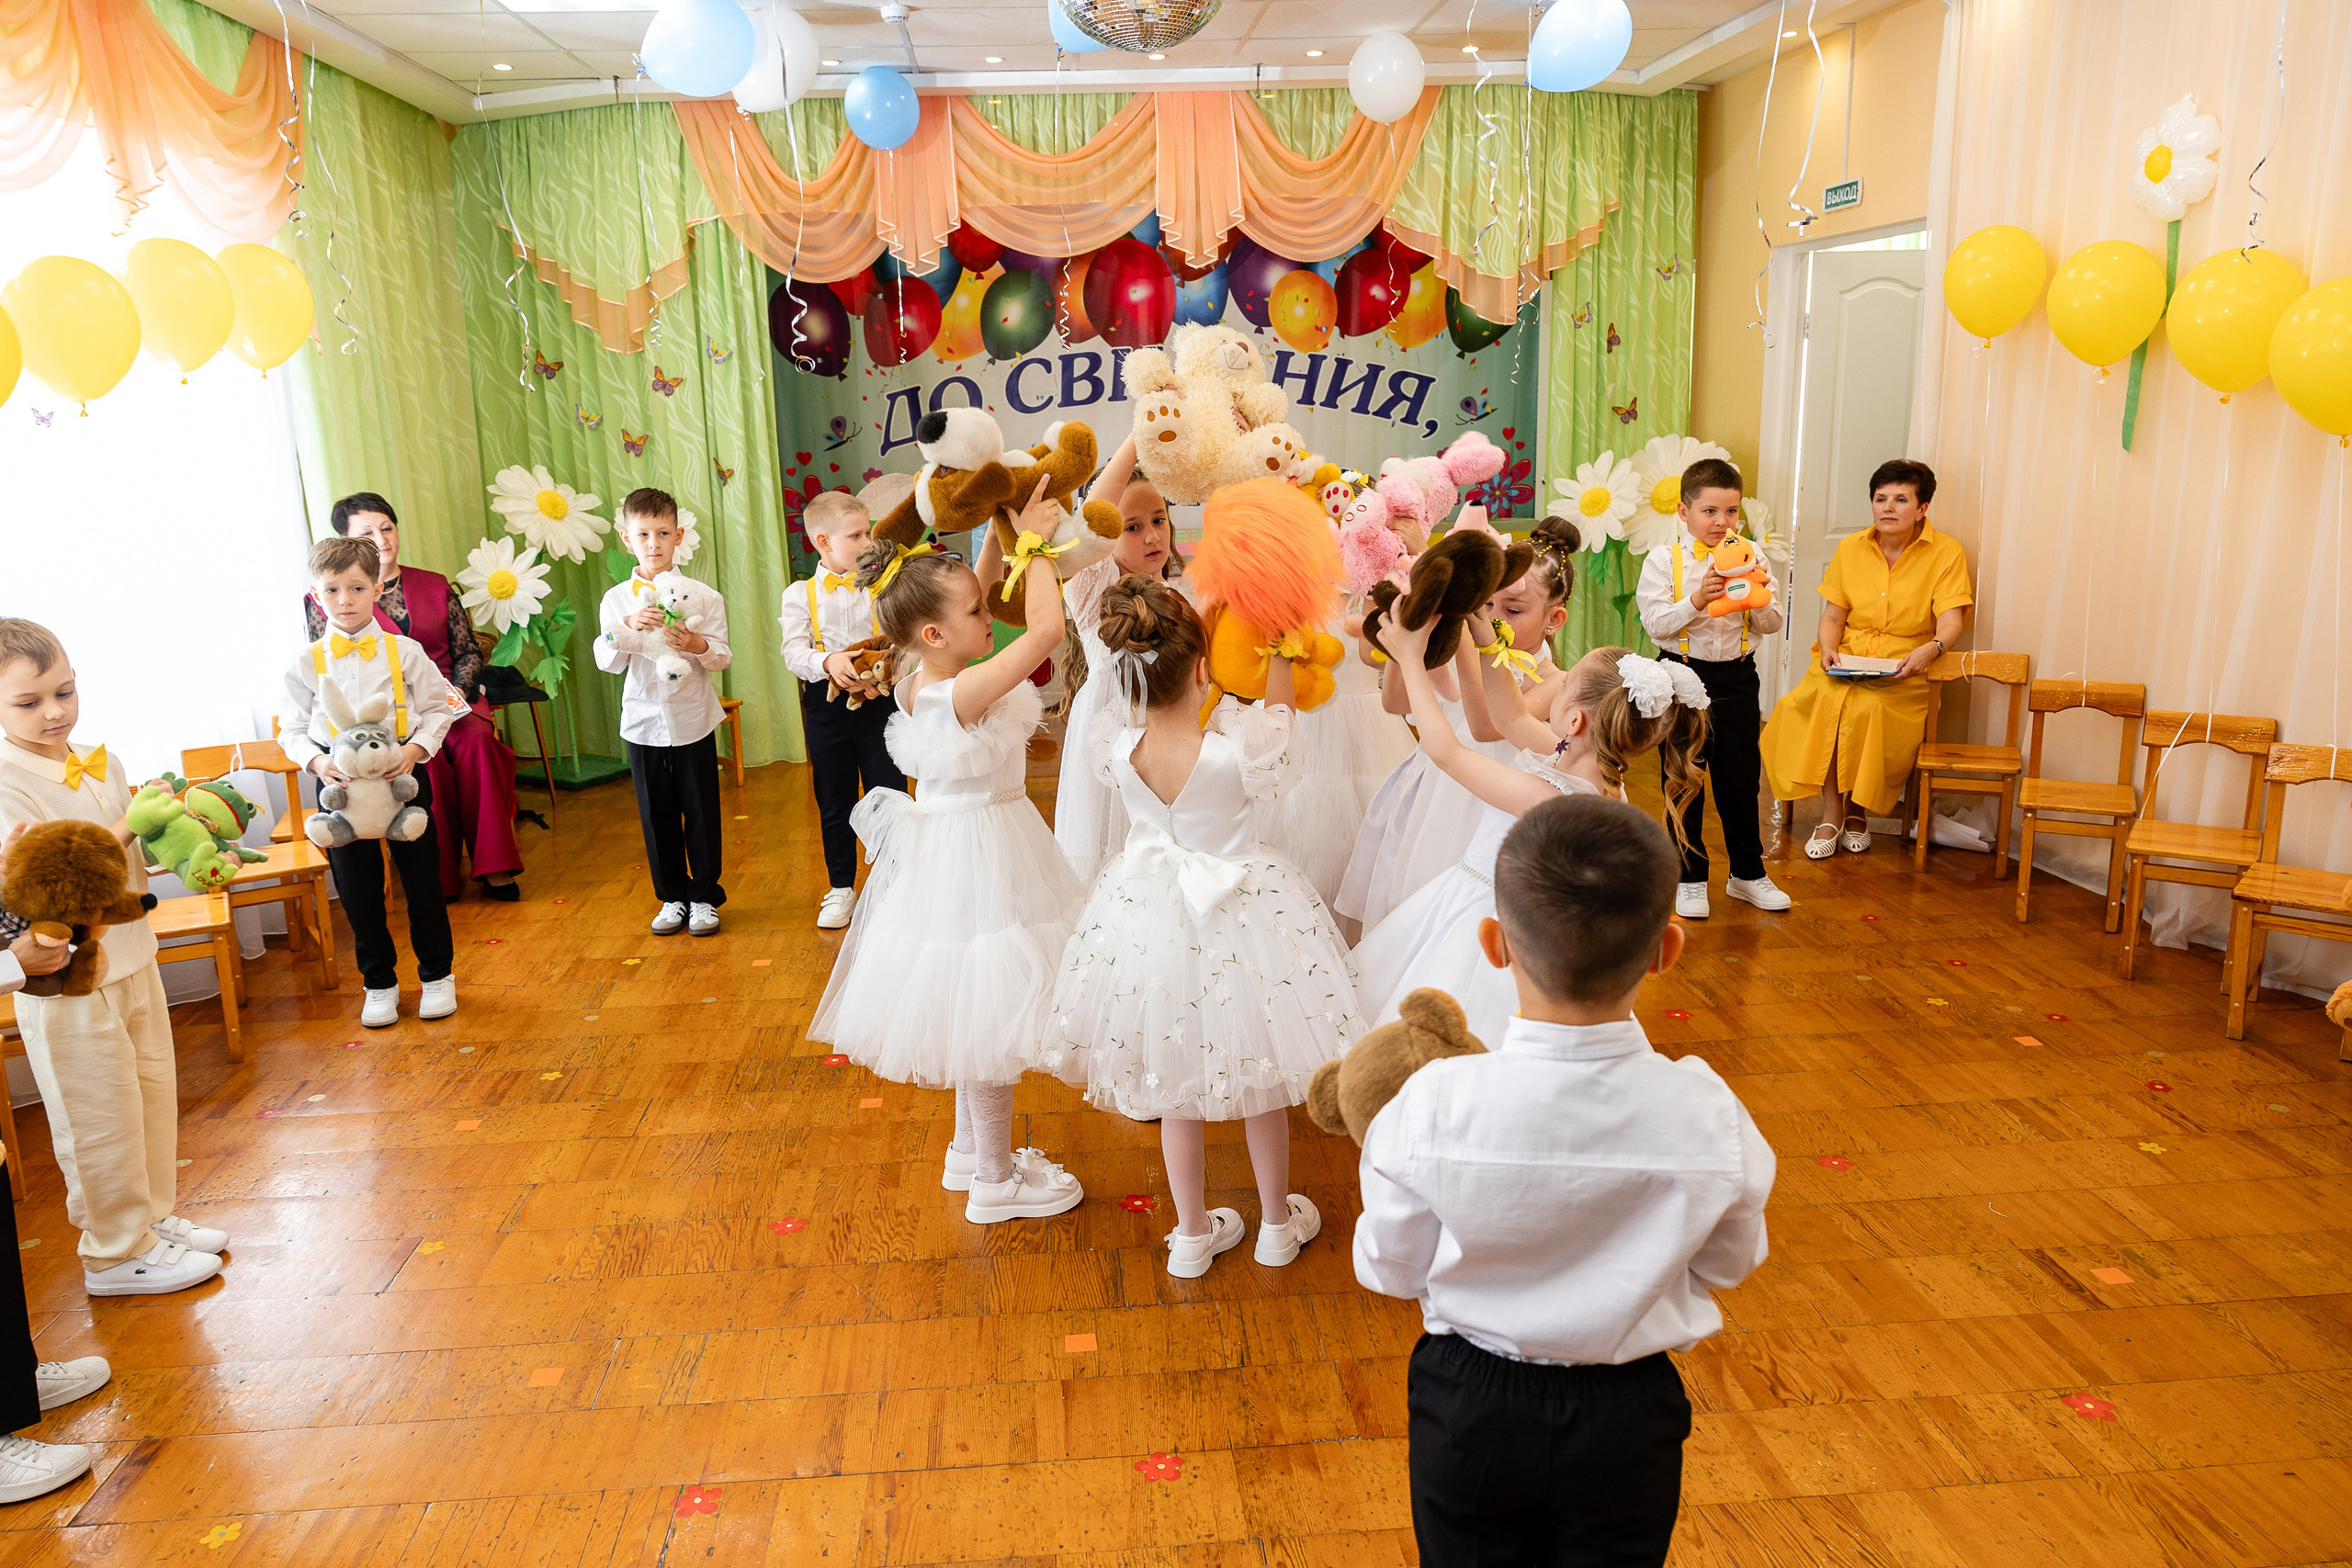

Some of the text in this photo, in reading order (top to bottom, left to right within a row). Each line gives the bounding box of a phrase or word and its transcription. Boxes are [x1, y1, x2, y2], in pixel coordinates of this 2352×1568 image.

[1826, 186, 1857, 205] ВЫХОД
[879, 345, 1439, 457] ДО СВНИЯ,
